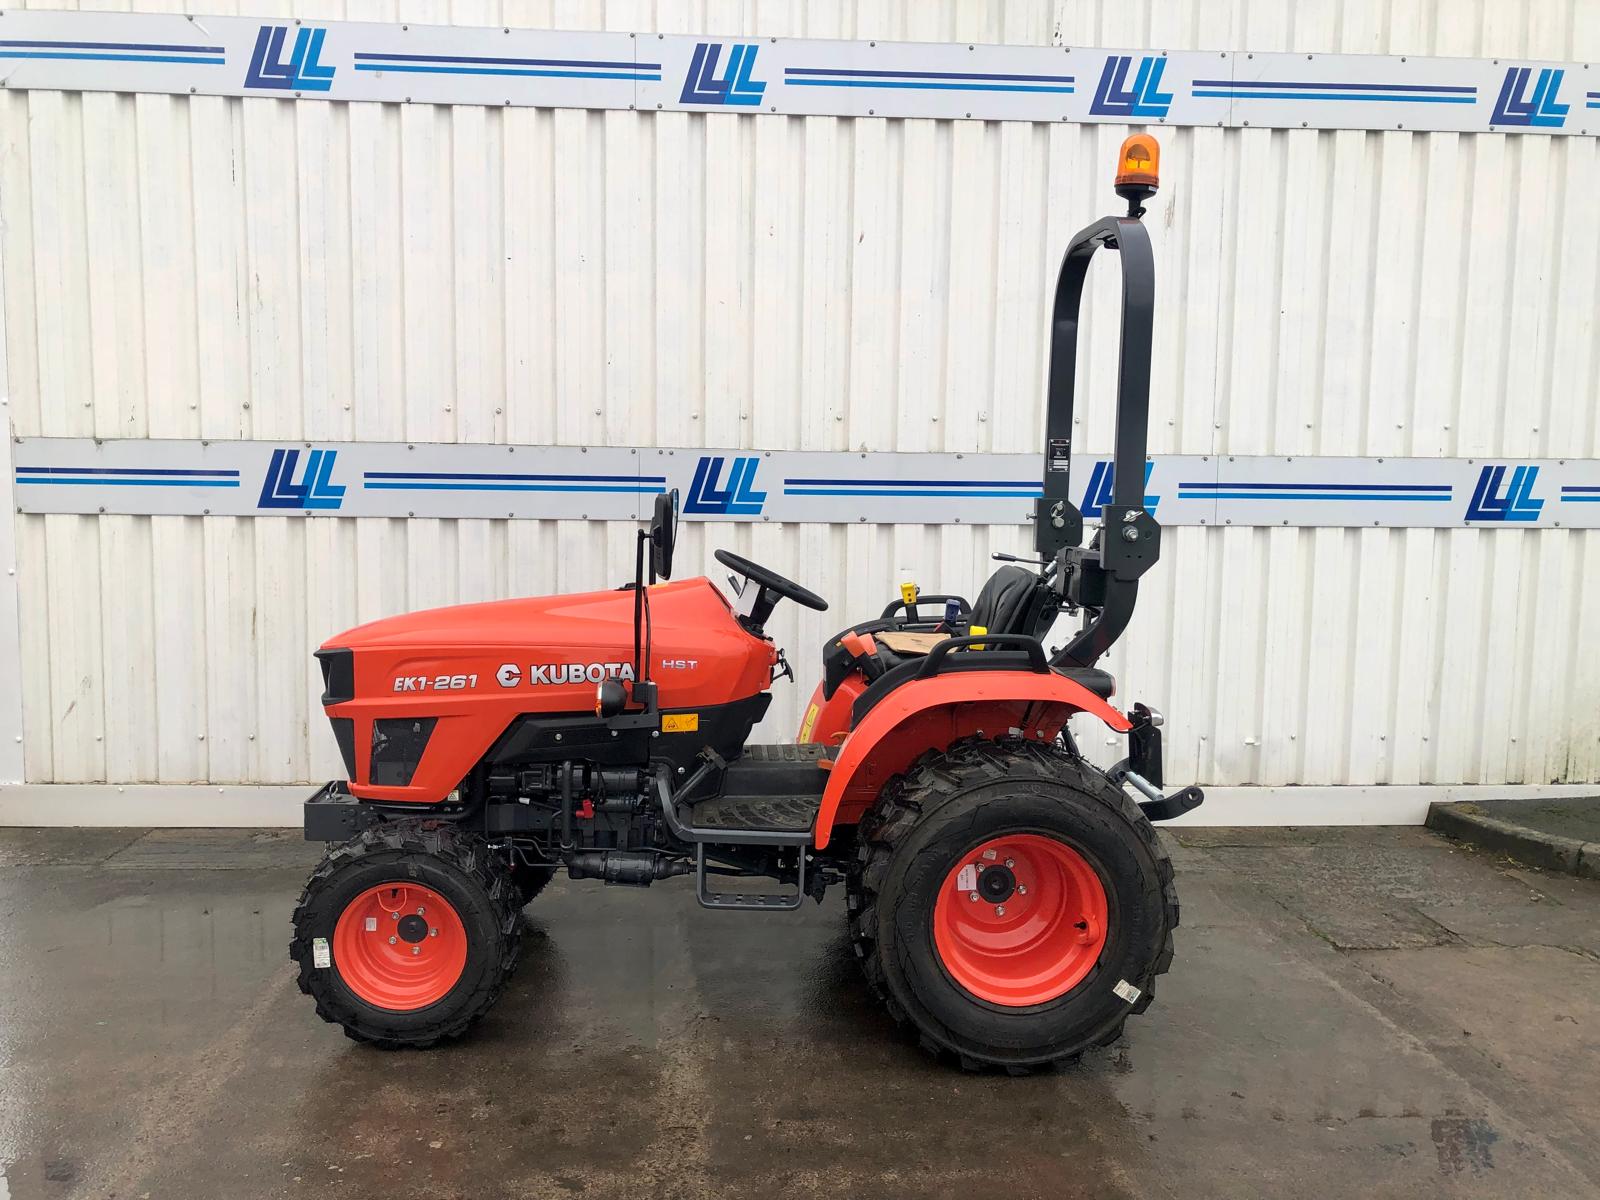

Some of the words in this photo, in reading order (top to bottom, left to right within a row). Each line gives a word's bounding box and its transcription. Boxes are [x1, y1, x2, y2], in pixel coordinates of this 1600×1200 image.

[529, 662, 635, 684] KUBOTA
[662, 659, 698, 670] HST
[393, 674, 478, 692] EK1-261
